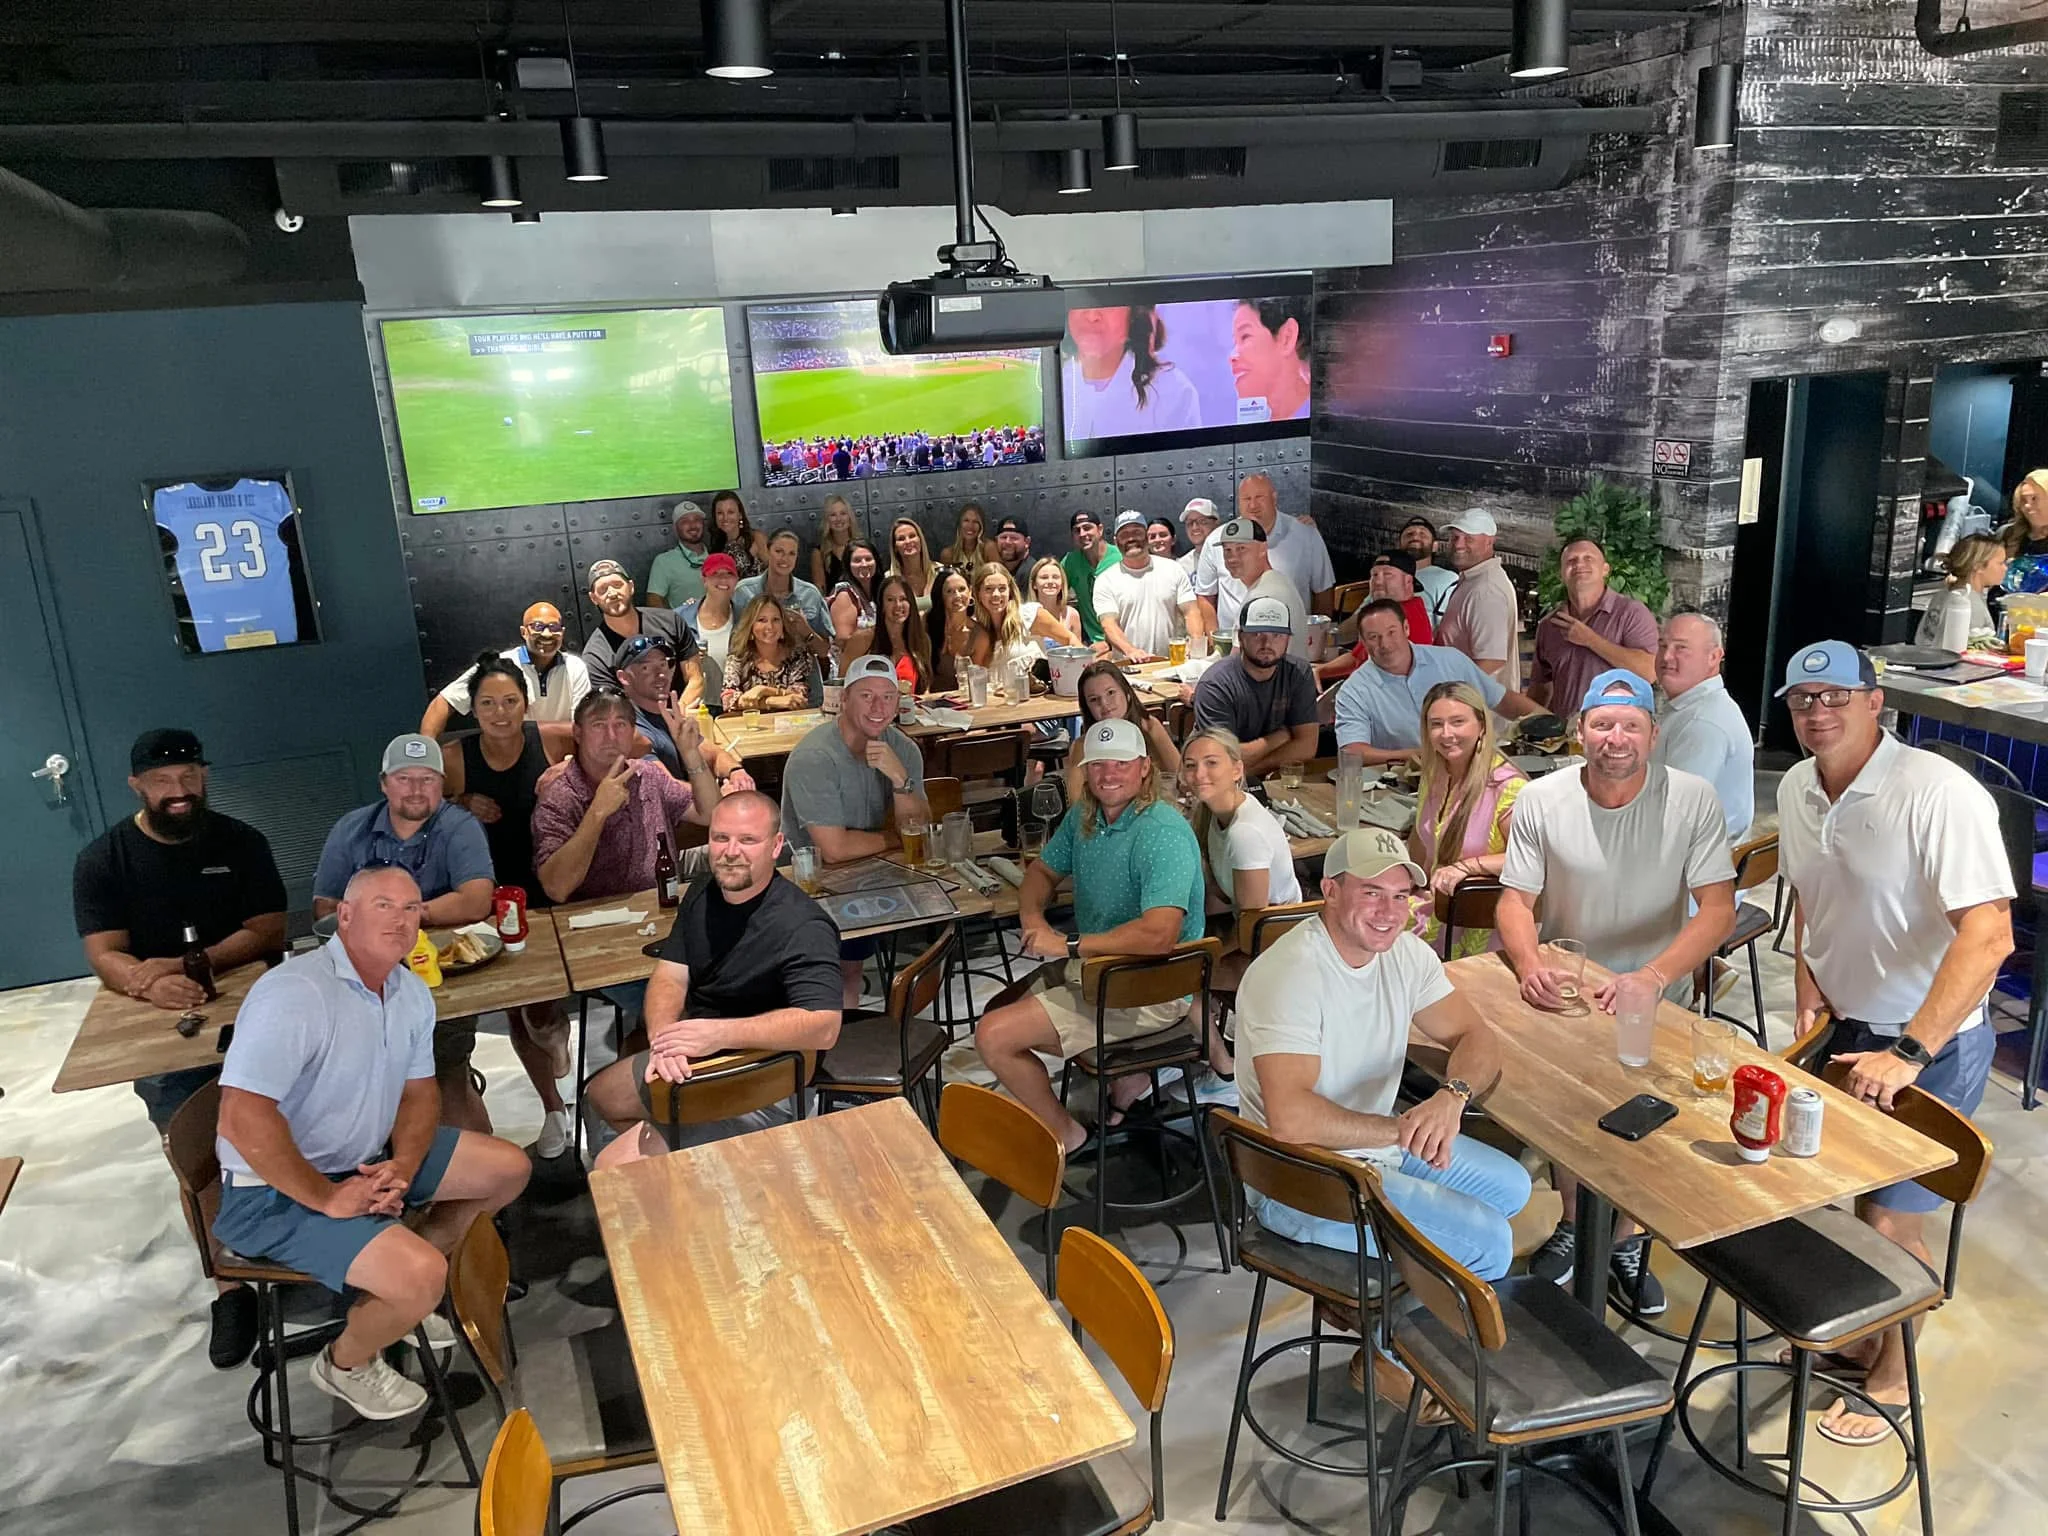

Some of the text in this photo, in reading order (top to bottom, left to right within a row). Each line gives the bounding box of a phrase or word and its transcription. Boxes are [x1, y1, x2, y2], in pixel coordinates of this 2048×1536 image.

[588, 330, 601, 338] FOR
[1654, 463, 1667, 475] NO
[195, 520, 267, 582] 23
